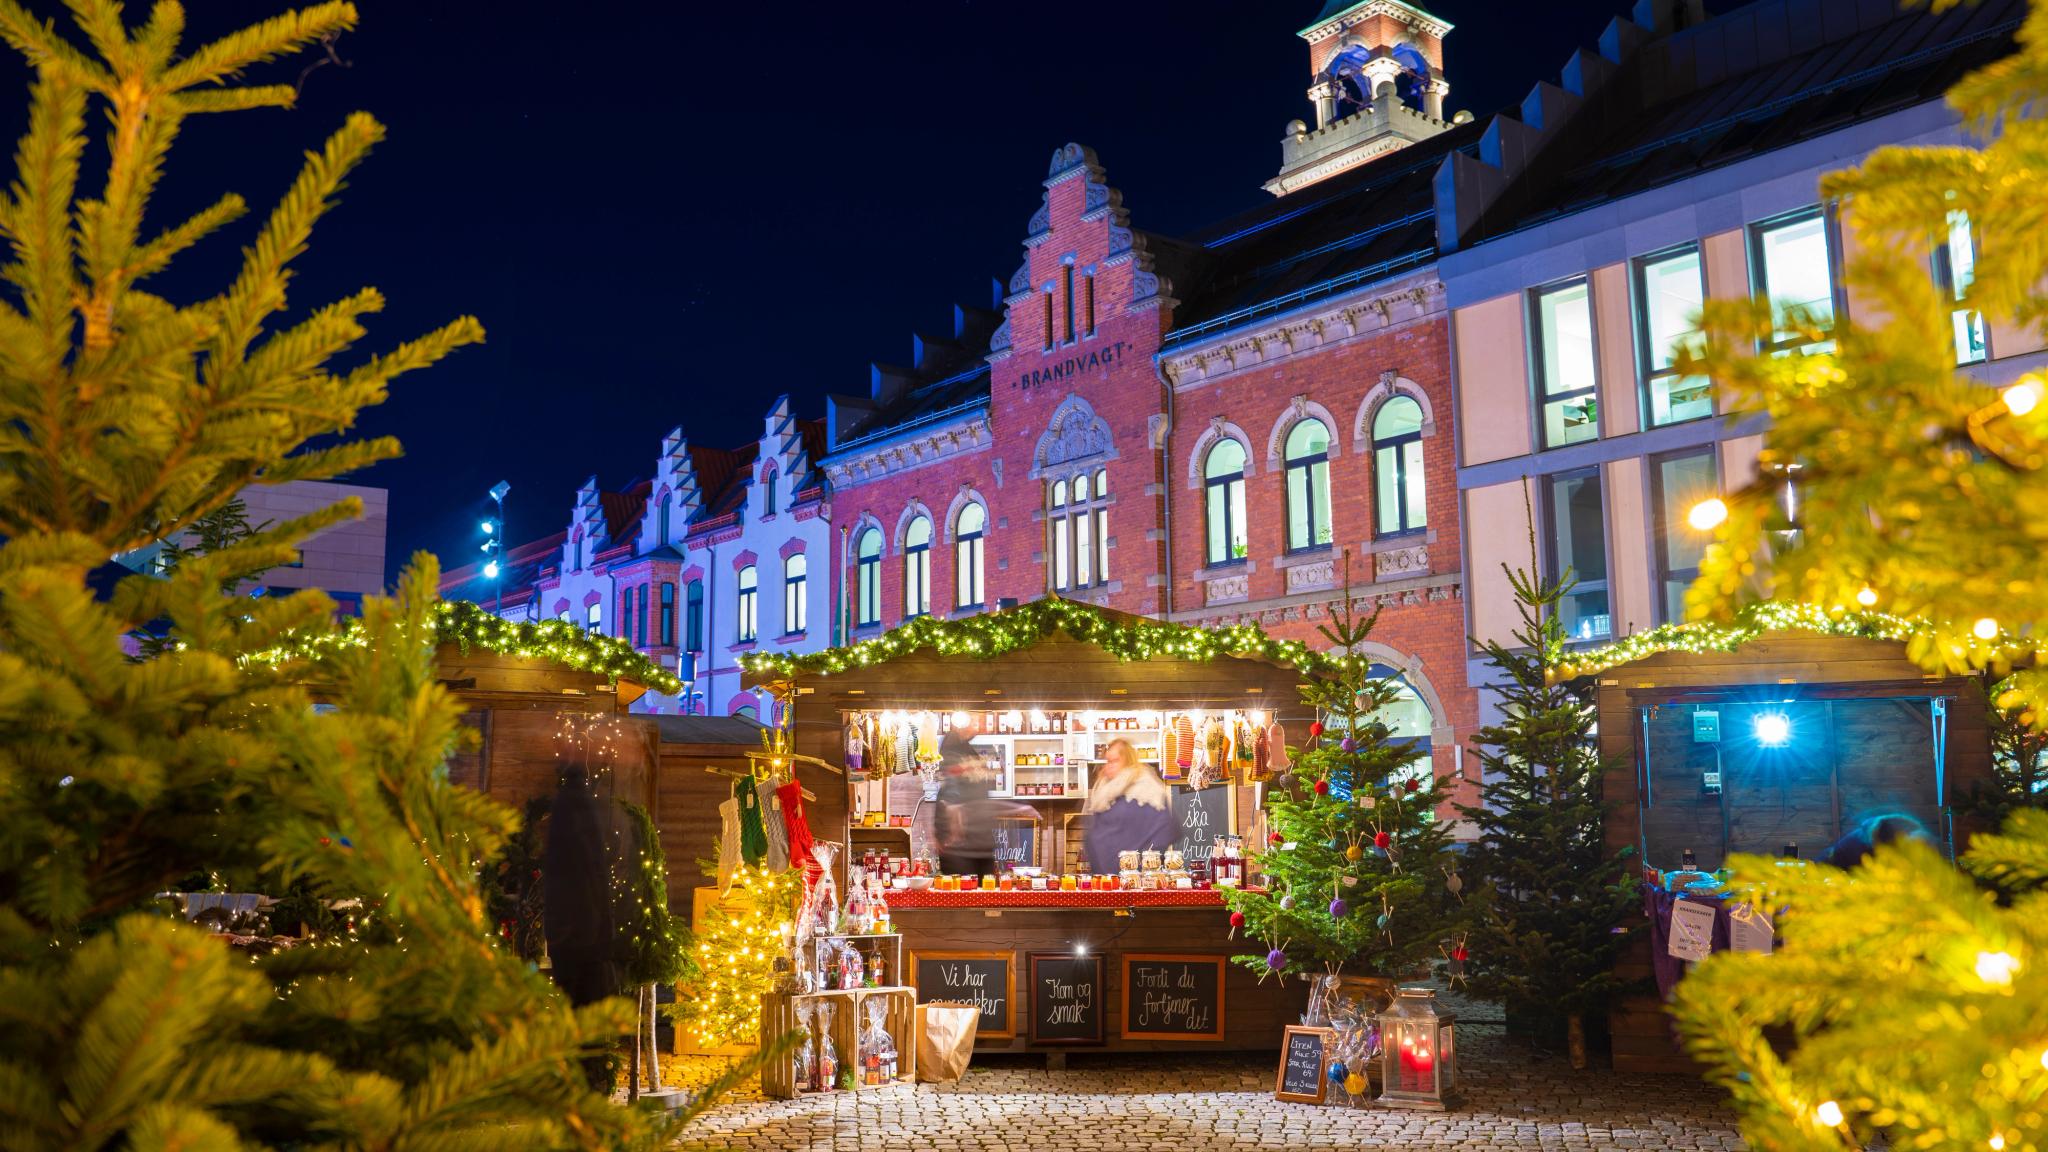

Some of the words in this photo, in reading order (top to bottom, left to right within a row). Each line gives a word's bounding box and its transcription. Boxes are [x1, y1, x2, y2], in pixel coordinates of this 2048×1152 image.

[1022, 342, 1125, 389] BRANDVAGT
[941, 963, 960, 987] Vi
[963, 964, 989, 987] har
[1137, 967, 1170, 988] Fordi
[1178, 965, 1195, 988] du
[1046, 978, 1074, 999] Kom
[1077, 983, 1091, 1009] og
[1046, 1000, 1086, 1025] smak
[1139, 992, 1198, 1026] fortjener
[1186, 1006, 1209, 1030] det
